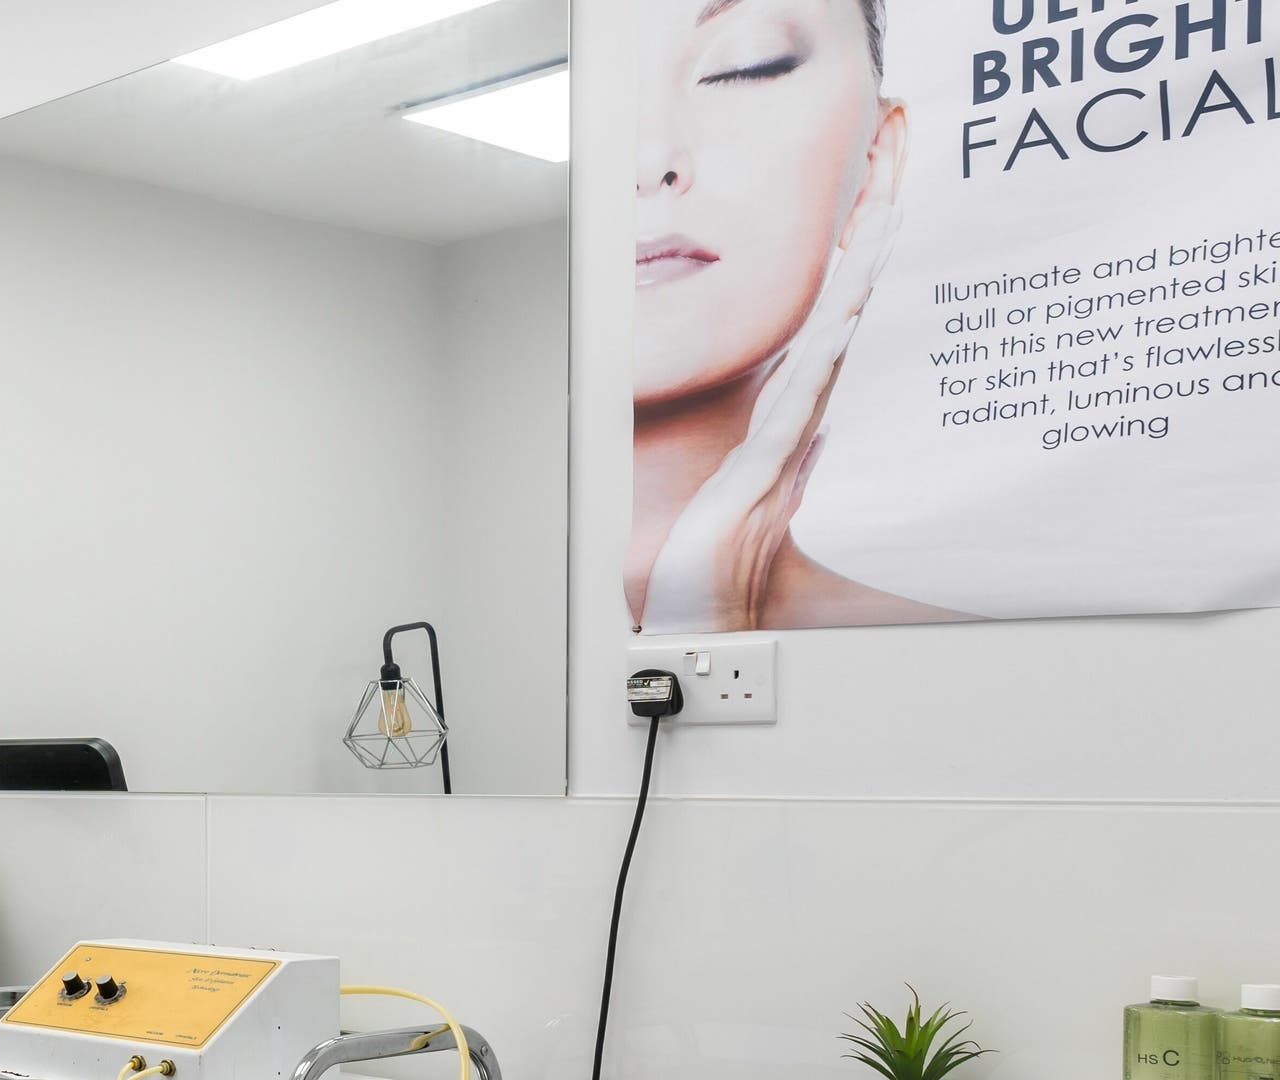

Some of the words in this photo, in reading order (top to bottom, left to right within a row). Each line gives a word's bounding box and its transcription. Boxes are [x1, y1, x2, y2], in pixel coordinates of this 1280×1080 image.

[973, 0, 1262, 105] BRIGHT
[963, 57, 1280, 179] FACIAL
[935, 265, 1081, 304] Illuminate
[1093, 248, 1157, 279] and
[945, 308, 996, 334] dull
[1007, 305, 1036, 325] or
[1046, 269, 1226, 324] pigmented
[930, 341, 988, 366] with
[1000, 333, 1045, 357] this
[1057, 324, 1123, 349] new
[940, 377, 977, 397] for
[985, 367, 1036, 391] skin
[1048, 352, 1134, 382] that's
[942, 394, 1056, 427] radiant,
[1068, 377, 1210, 411] luminous
[1042, 415, 1169, 450] glowing
[1138, 1054, 1158, 1065] HS
[1163, 1050, 1180, 1067] C
